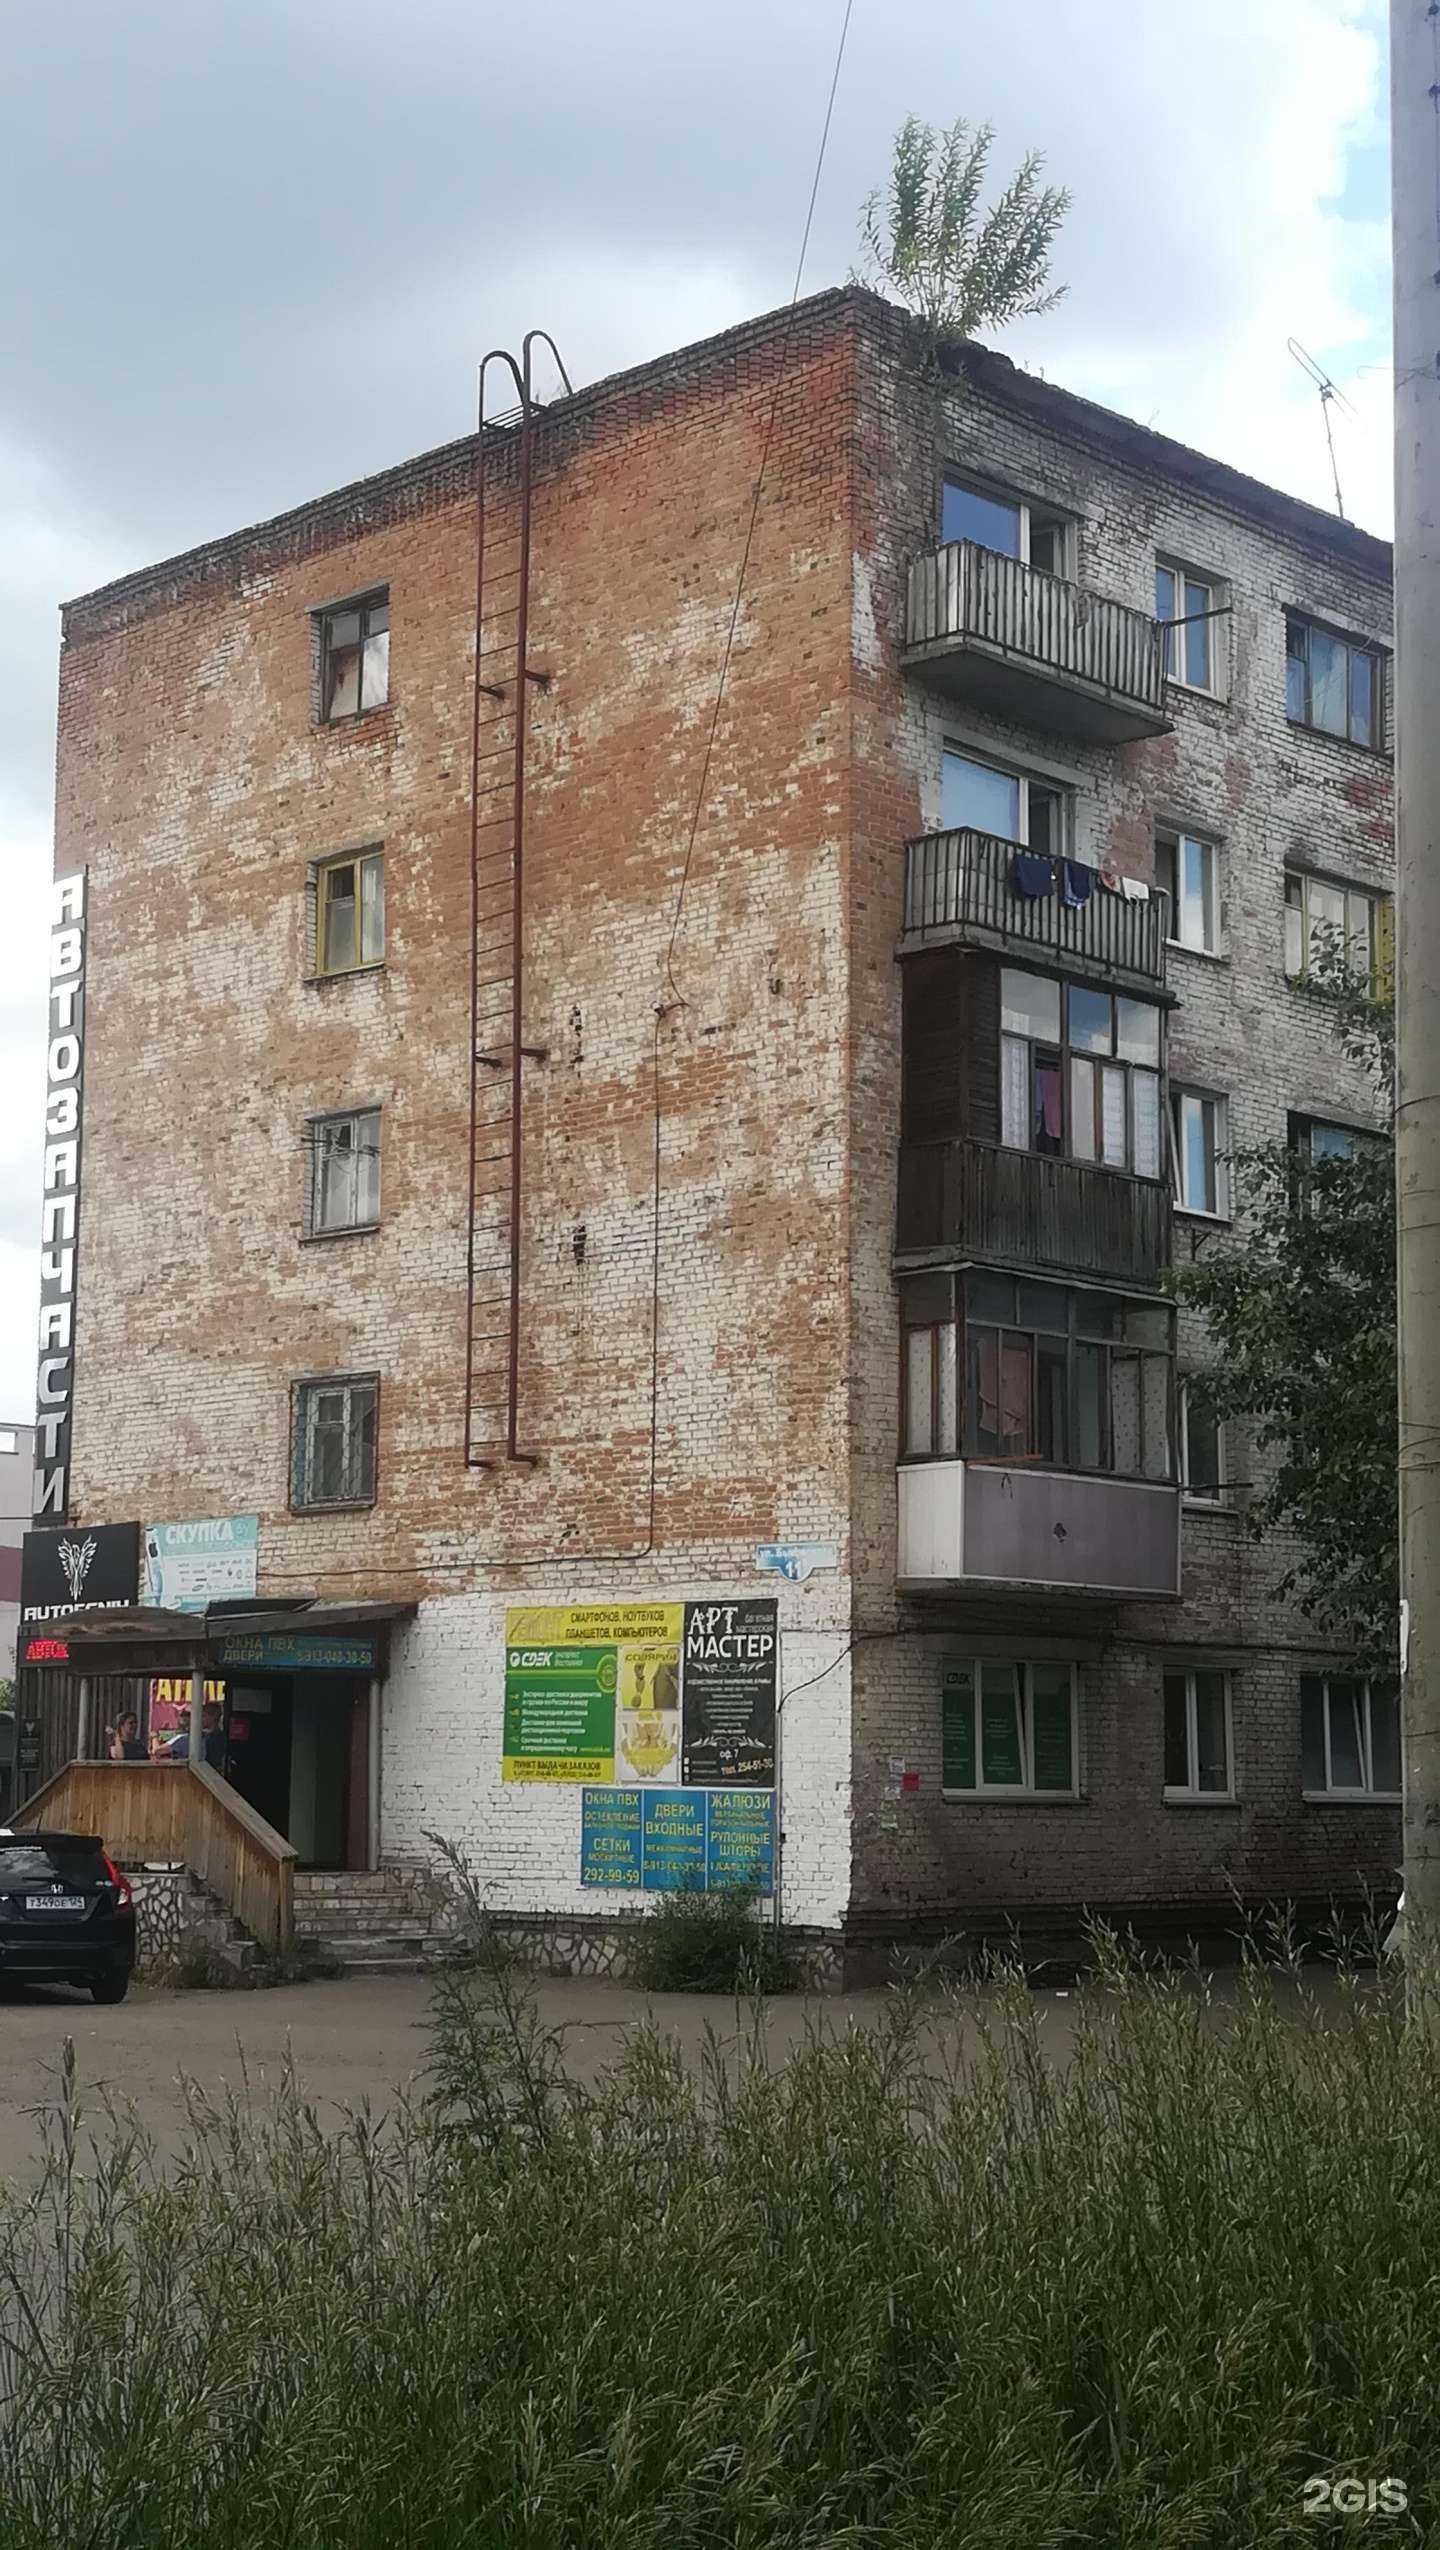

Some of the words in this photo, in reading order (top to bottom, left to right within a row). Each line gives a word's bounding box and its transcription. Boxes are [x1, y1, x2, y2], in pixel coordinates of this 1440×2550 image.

[35, 874, 84, 1513] АВТОЗАПЧАСТИ
[166, 1519, 234, 1545] СКУПКА
[571, 1612, 621, 1624] СМАРТФОНОВ,
[623, 1610, 665, 1622] НОУТБУКОВ
[688, 1606, 739, 1634] АРТ
[565, 1628, 611, 1640] ПЛАНШЕТОВ,
[613, 1626, 668, 1639] КОМПЬЮТЕРОВ
[225, 1635, 263, 1649] ОКНА
[687, 1634, 774, 1658] МАСТЕР
[223, 1650, 263, 1663] ДВЕРИ
[513, 1761, 537, 1770] ПУНКТ
[569, 1761, 601, 1770] ЗАКАЗОВ
[585, 1791, 614, 1805] ОКНА
[618, 1792, 639, 1806] ПВХ
[711, 1794, 771, 1809] ЖАЛЮЗИ
[655, 1804, 695, 1819] ДВЕРИ
[645, 1822, 704, 1837] ВХОДНЫЕ
[593, 1838, 631, 1852] СЕТКИ
[711, 1831, 770, 1845] РУЛОННЫЕ
[720, 1845, 761, 1857] ШТОРЫ
